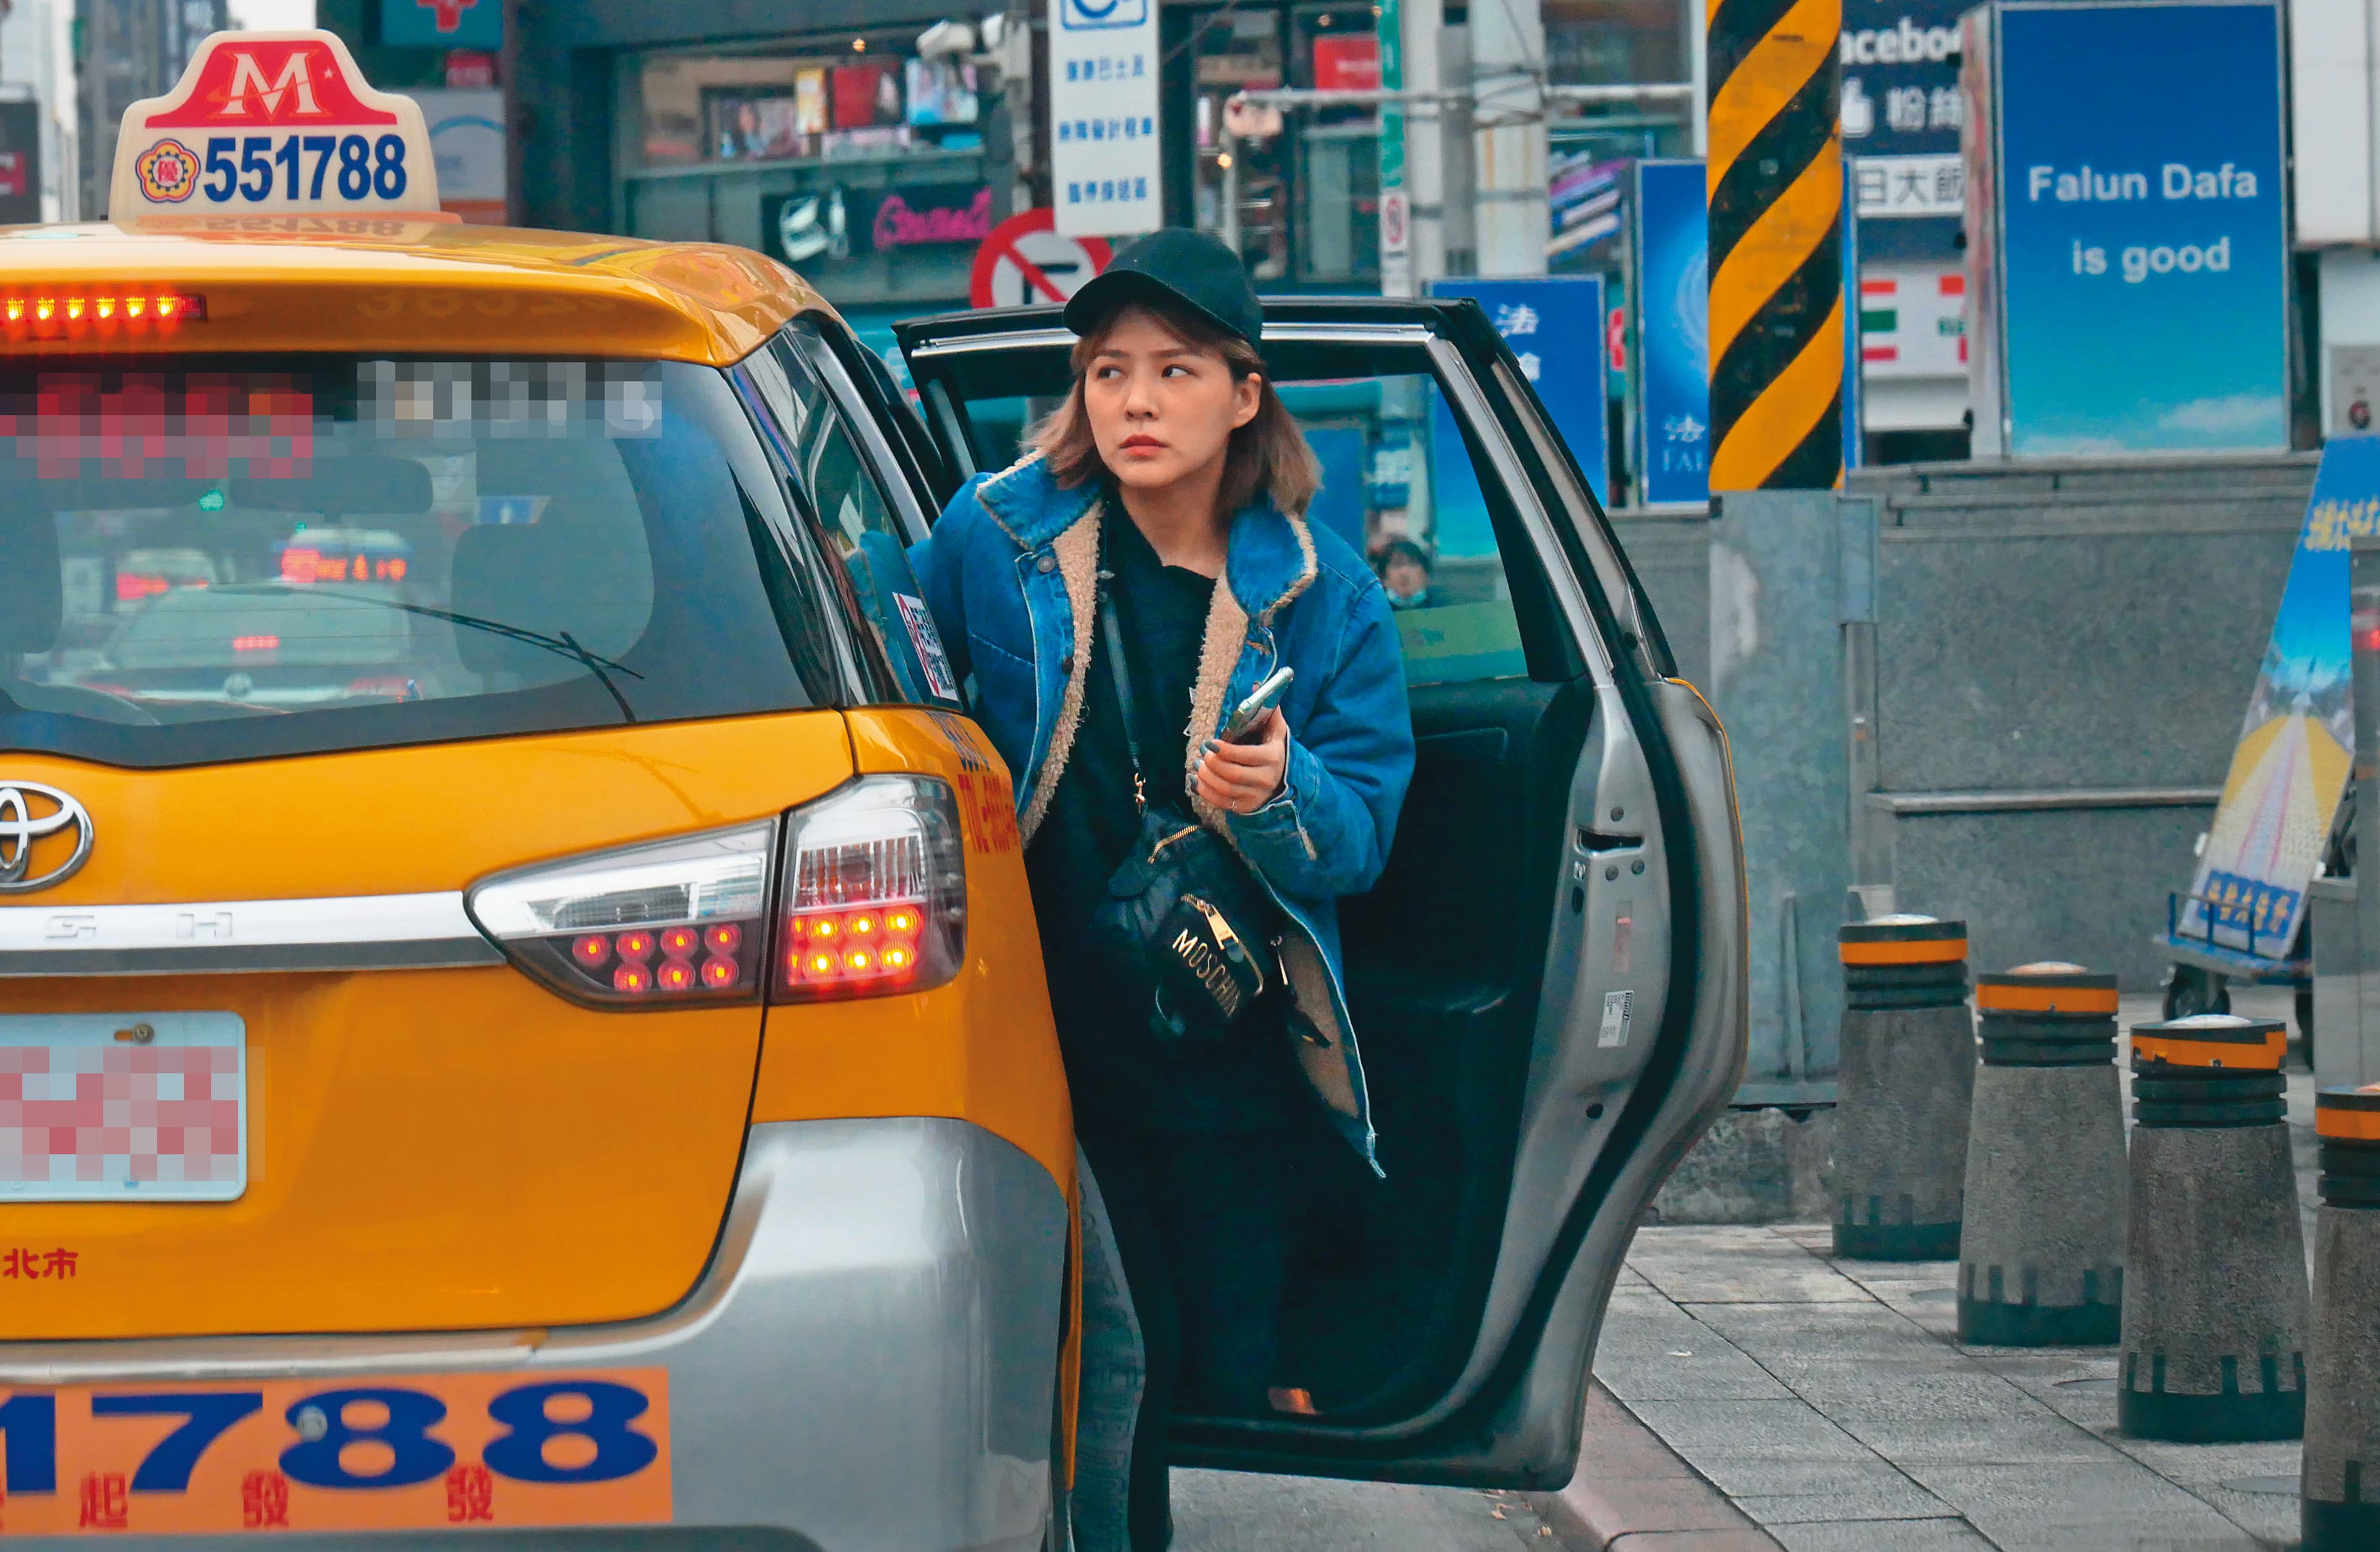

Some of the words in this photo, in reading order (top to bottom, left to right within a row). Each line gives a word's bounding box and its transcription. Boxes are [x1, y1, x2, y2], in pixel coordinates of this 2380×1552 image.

[204, 134, 407, 203] 551788
[2029, 165, 2148, 201] Falun
[2162, 163, 2258, 200] Dafa
[2073, 239, 2107, 275] is
[2122, 236, 2231, 283] good
[3, 1248, 78, 1280] 北市
